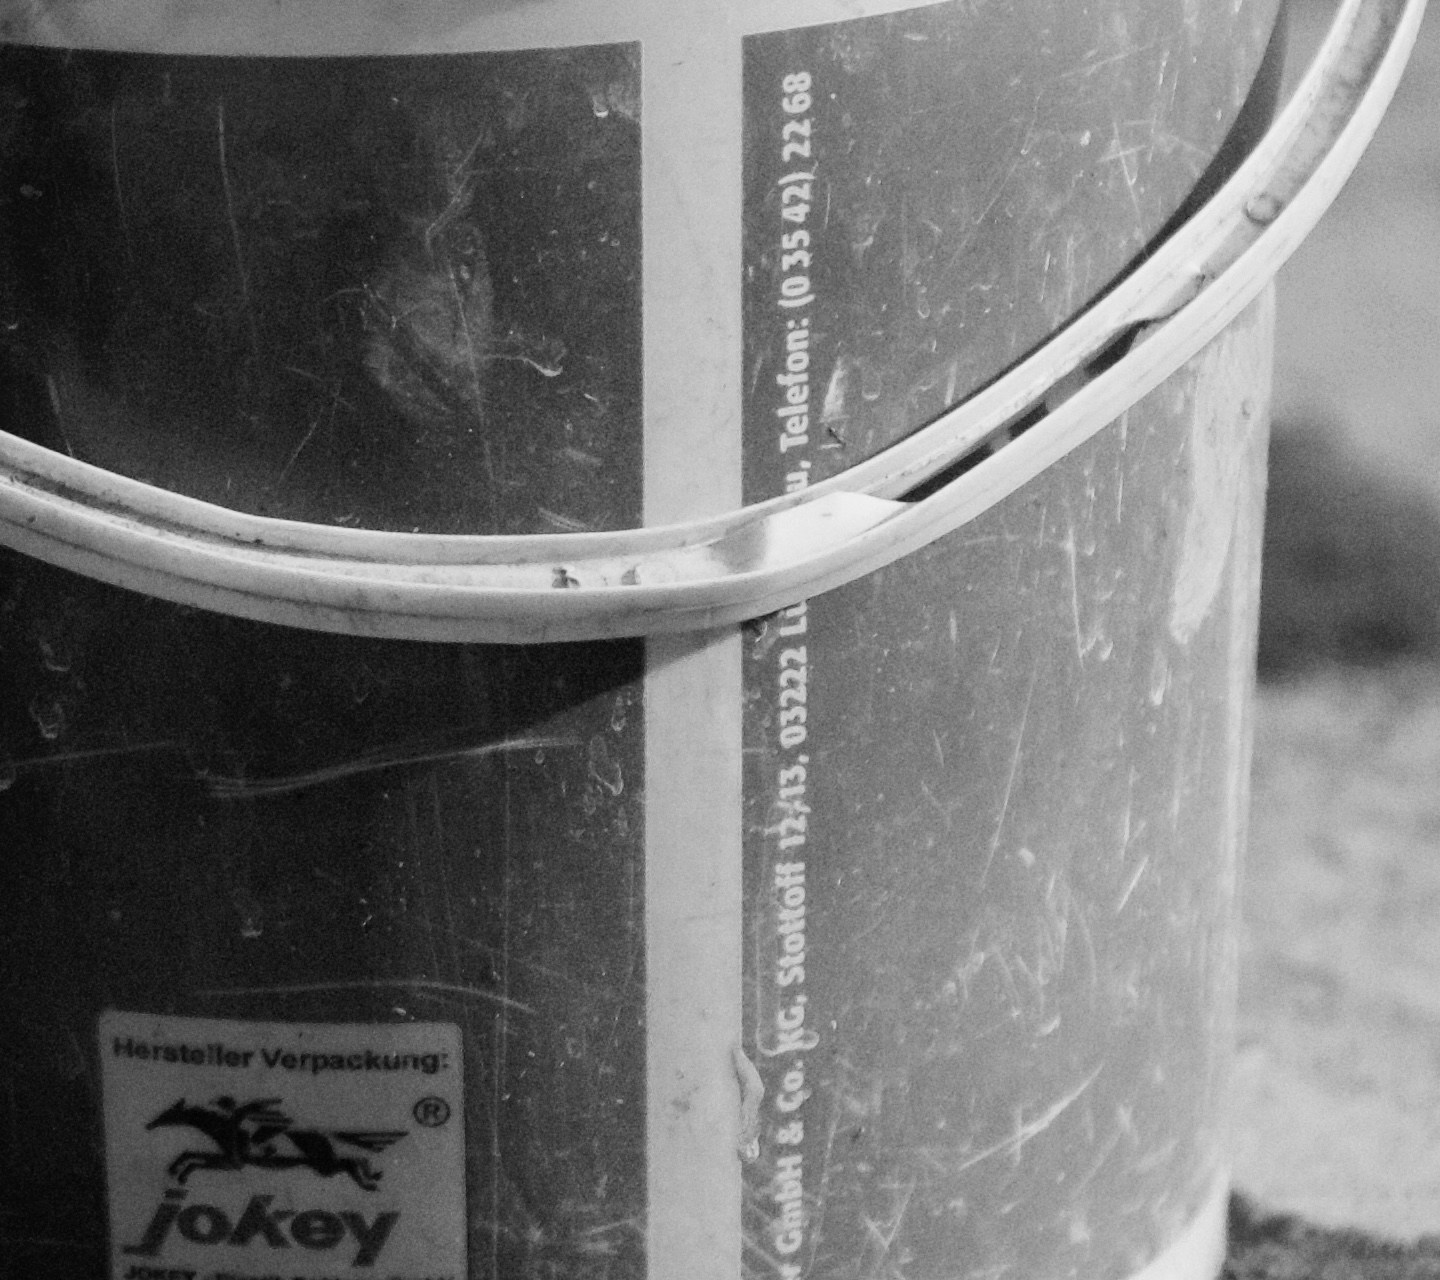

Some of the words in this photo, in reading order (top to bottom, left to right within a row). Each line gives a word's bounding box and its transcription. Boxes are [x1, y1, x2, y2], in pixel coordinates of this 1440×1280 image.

[776, 318, 810, 453] Telefon:
[779, 646, 808, 749] 03222
[112, 1037, 254, 1068] Hersteller
[261, 1046, 450, 1074] Verpackung:
[776, 995, 807, 1052] KG,
[776, 1060, 805, 1112] Co.
[777, 1121, 805, 1145] &
[123, 1187, 401, 1267] jokey
[774, 1153, 803, 1254] GmbH
